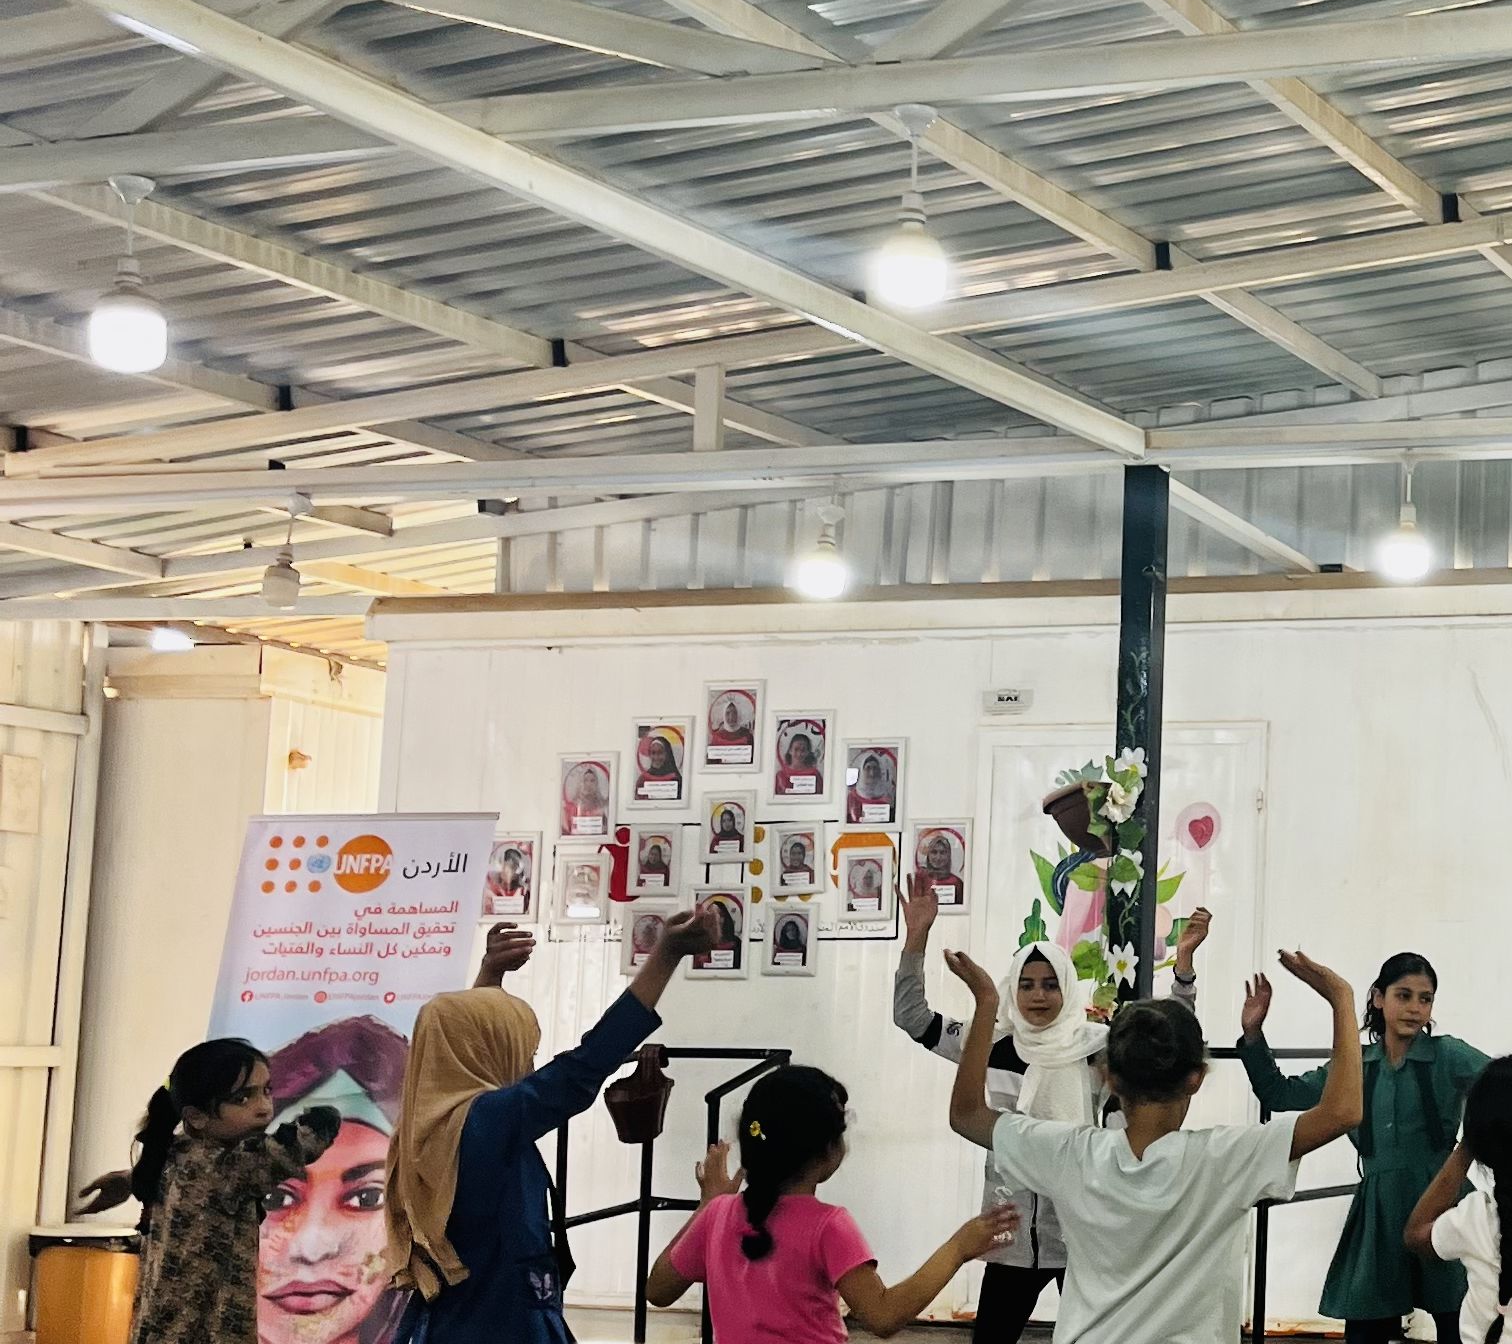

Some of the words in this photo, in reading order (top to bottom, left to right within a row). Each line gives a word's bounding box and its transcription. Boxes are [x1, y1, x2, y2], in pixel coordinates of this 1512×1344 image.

[334, 853, 393, 875] UNFPA
[402, 851, 468, 879] الأردن
[354, 903, 383, 920] في
[387, 900, 459, 915] المساهمة
[253, 921, 313, 938] الجنسين
[316, 924, 342, 938] بين
[346, 922, 411, 937] المساواة
[412, 921, 457, 939] تحقيق
[261, 940, 324, 958] والفتيات
[329, 941, 374, 956] النساء
[376, 942, 398, 958] كل
[401, 942, 452, 958] وتمكين
[243, 967, 380, 986] jordan.unfpa.org
